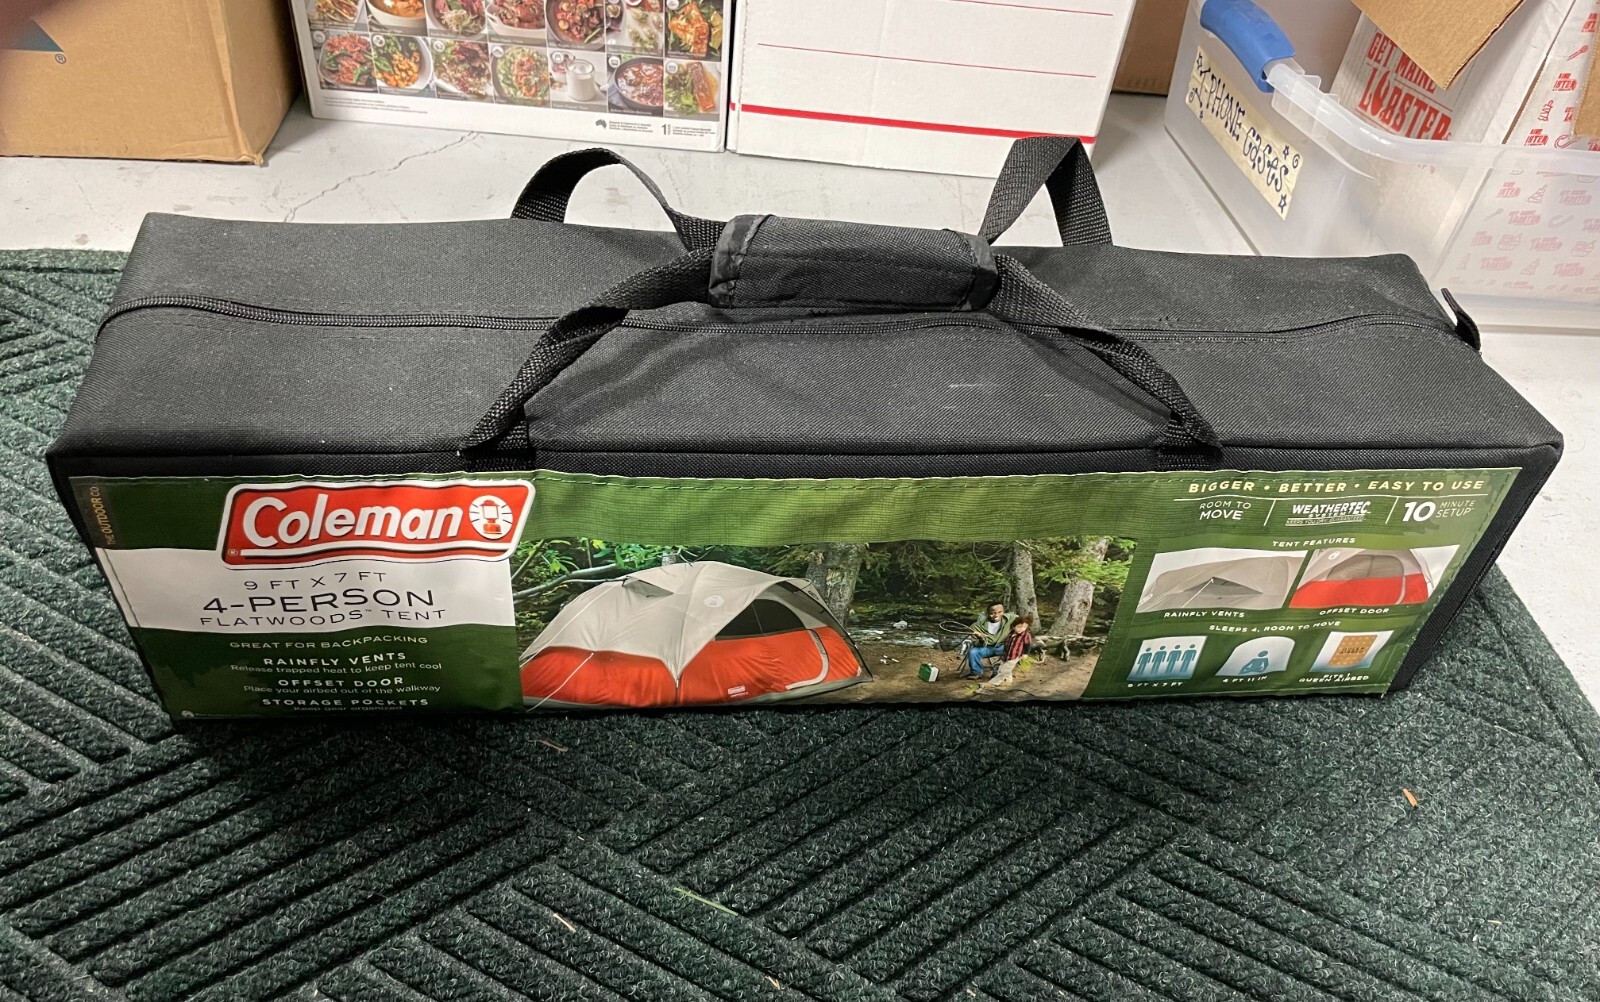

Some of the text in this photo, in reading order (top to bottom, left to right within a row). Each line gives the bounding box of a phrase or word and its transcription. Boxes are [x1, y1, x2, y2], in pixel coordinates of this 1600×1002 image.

[1367, 32, 1398, 67] GET
[1188, 480, 1484, 493] BIGGER BETTER EASY TO USE
[1200, 500, 1252, 509] ROOM TO
[1292, 501, 1371, 514] WEATHERTEC
[1440, 500, 1476, 508] MINUTE
[90, 497, 112, 536] OUTDOOR
[1200, 509, 1243, 520] MOVE
[1402, 501, 1436, 522] 10
[243, 494, 464, 548] Coleman
[1303, 538, 1356, 546] FEATURES
[244, 571, 387, 590] 9 FT X 7 FT
[203, 588, 434, 614] 4-PERSON
[381, 609, 446, 621] TENT
[1211, 610, 1245, 618] VENTS
[1209, 624, 1248, 633] SLEEPS
[321, 635, 428, 648] BACKPACKING
[263, 652, 406, 666] RAINFLY VENTS
[230, 664, 273, 673] Release
[276, 666, 320, 674] trapped
[365, 664, 391, 673] keep
[394, 661, 416, 669] tent
[278, 676, 404, 687] OFFSET DOOR
[244, 685, 273, 693] Place
[303, 686, 338, 694] airbed
[361, 686, 372, 694] of
[396, 684, 441, 694] walkway
